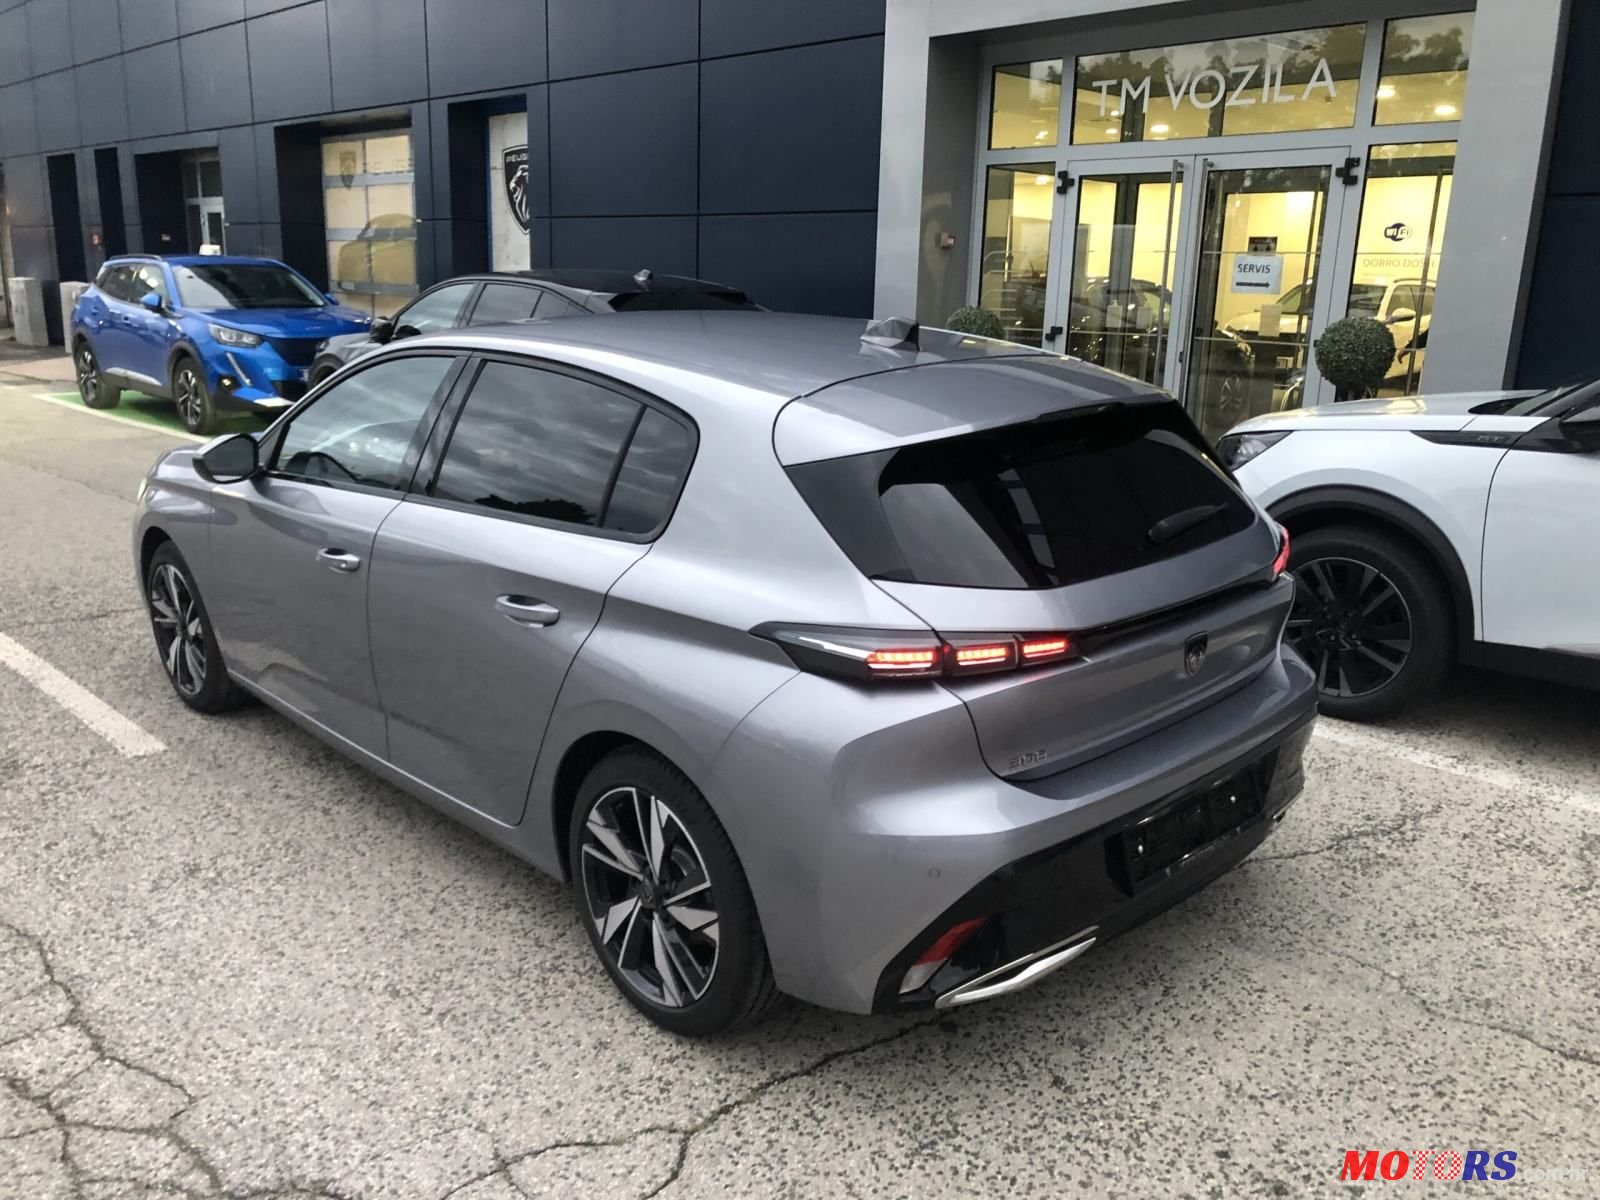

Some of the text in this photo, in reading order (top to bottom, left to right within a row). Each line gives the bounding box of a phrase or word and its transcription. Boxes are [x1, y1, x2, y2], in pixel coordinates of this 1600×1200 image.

[1092, 58, 1337, 117] TM VOZILA
[1237, 263, 1271, 274] SERVIS
[1362, 258, 1401, 268] DOBRO
